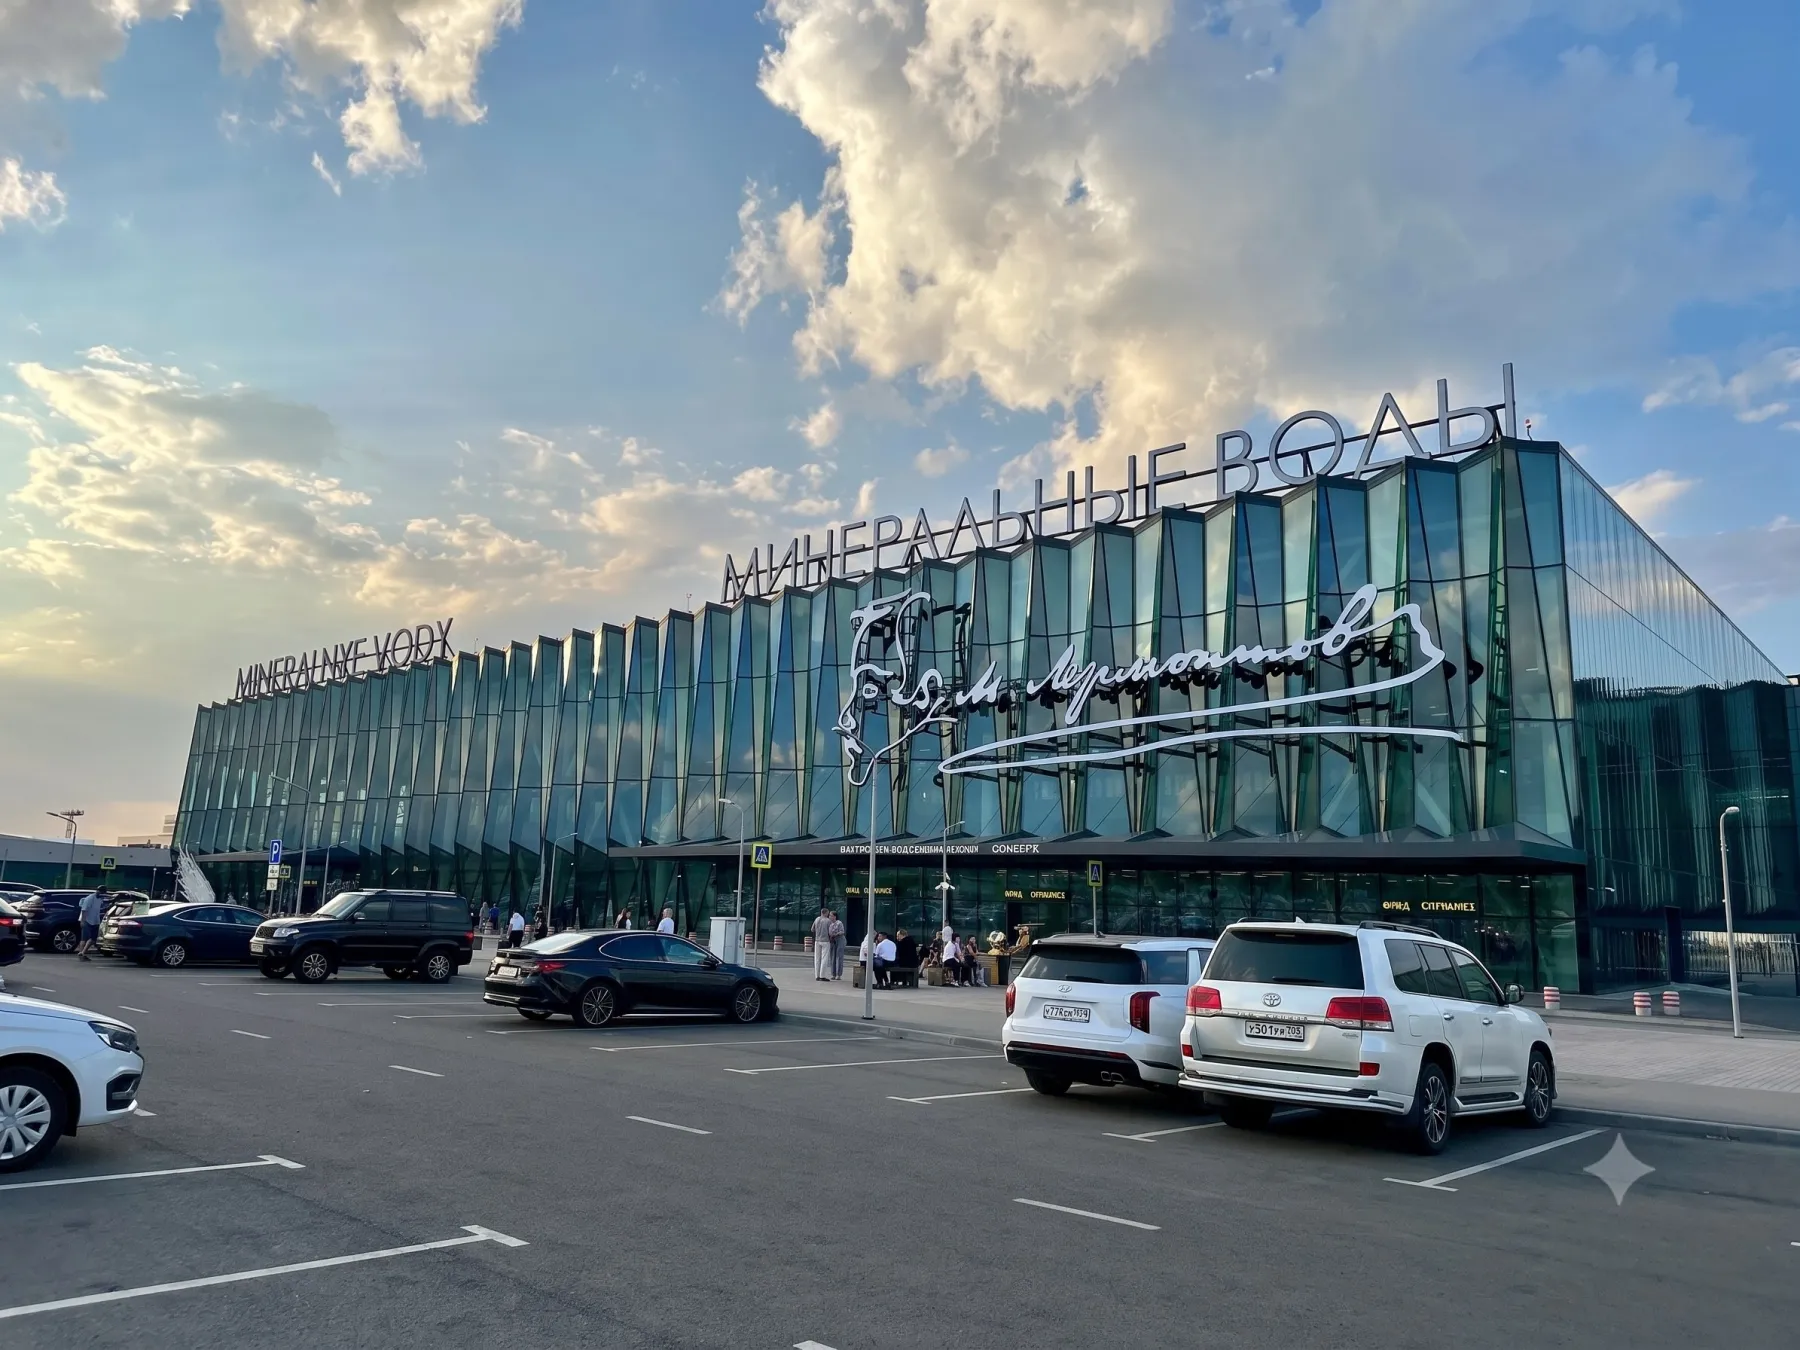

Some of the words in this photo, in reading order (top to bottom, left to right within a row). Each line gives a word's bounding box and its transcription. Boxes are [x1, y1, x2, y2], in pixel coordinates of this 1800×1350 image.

[720, 442, 1187, 604] МИНЕРАЛЬНЫЕ
[1216, 362, 1517, 501] ВОДЫ
[271, 842, 279, 861] P
